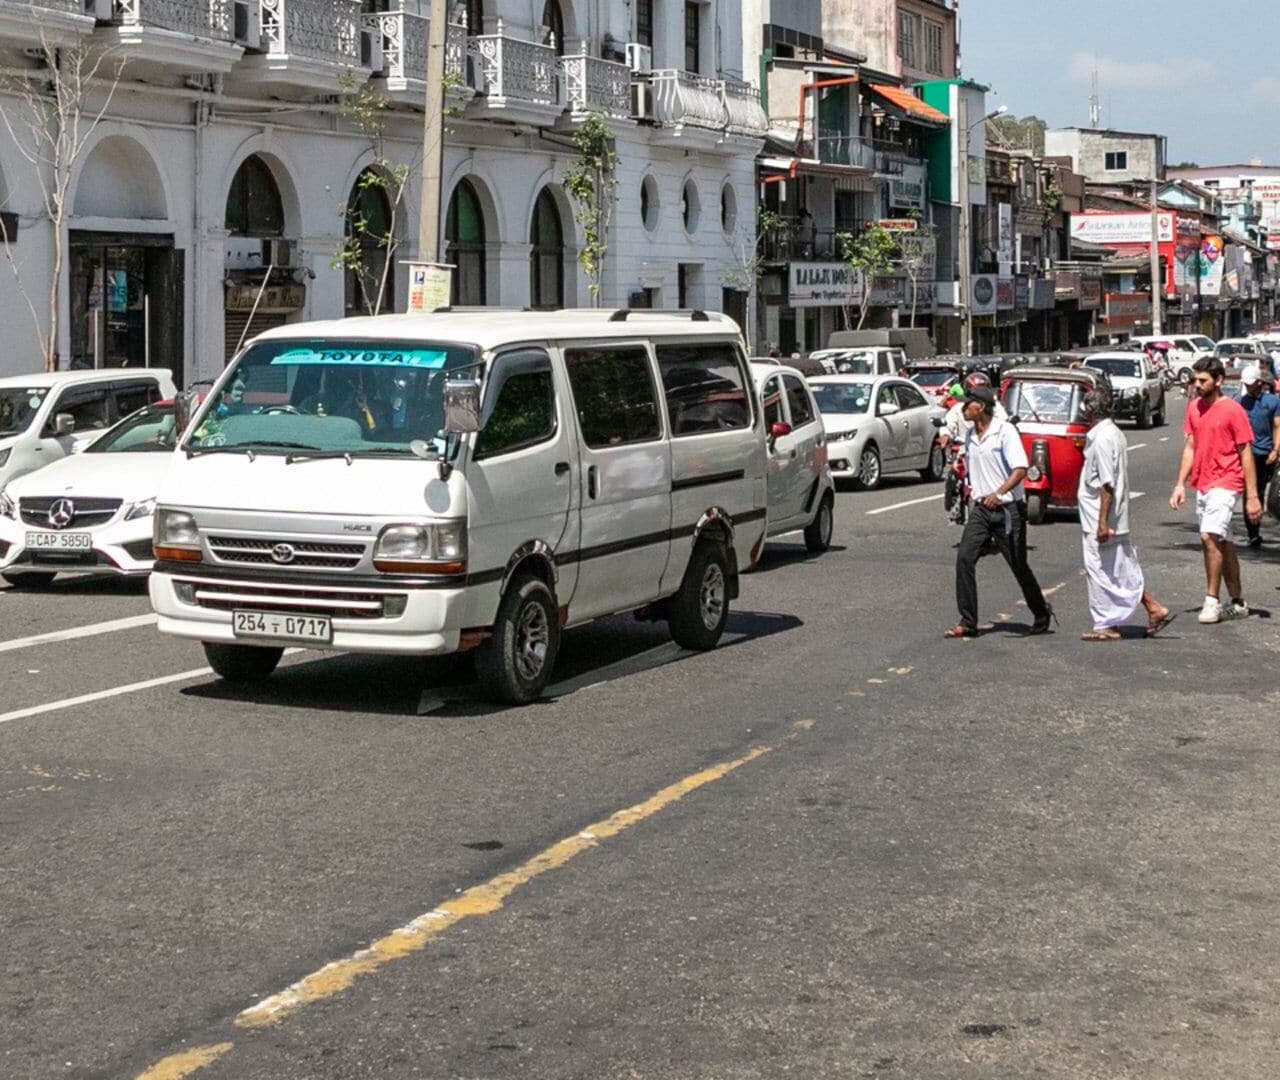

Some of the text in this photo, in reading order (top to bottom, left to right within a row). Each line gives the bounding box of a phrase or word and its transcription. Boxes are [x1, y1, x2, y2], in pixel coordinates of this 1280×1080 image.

[320, 351, 404, 362] TOYOTA
[36, 534, 57, 546] CAP
[61, 534, 89, 547] 5850
